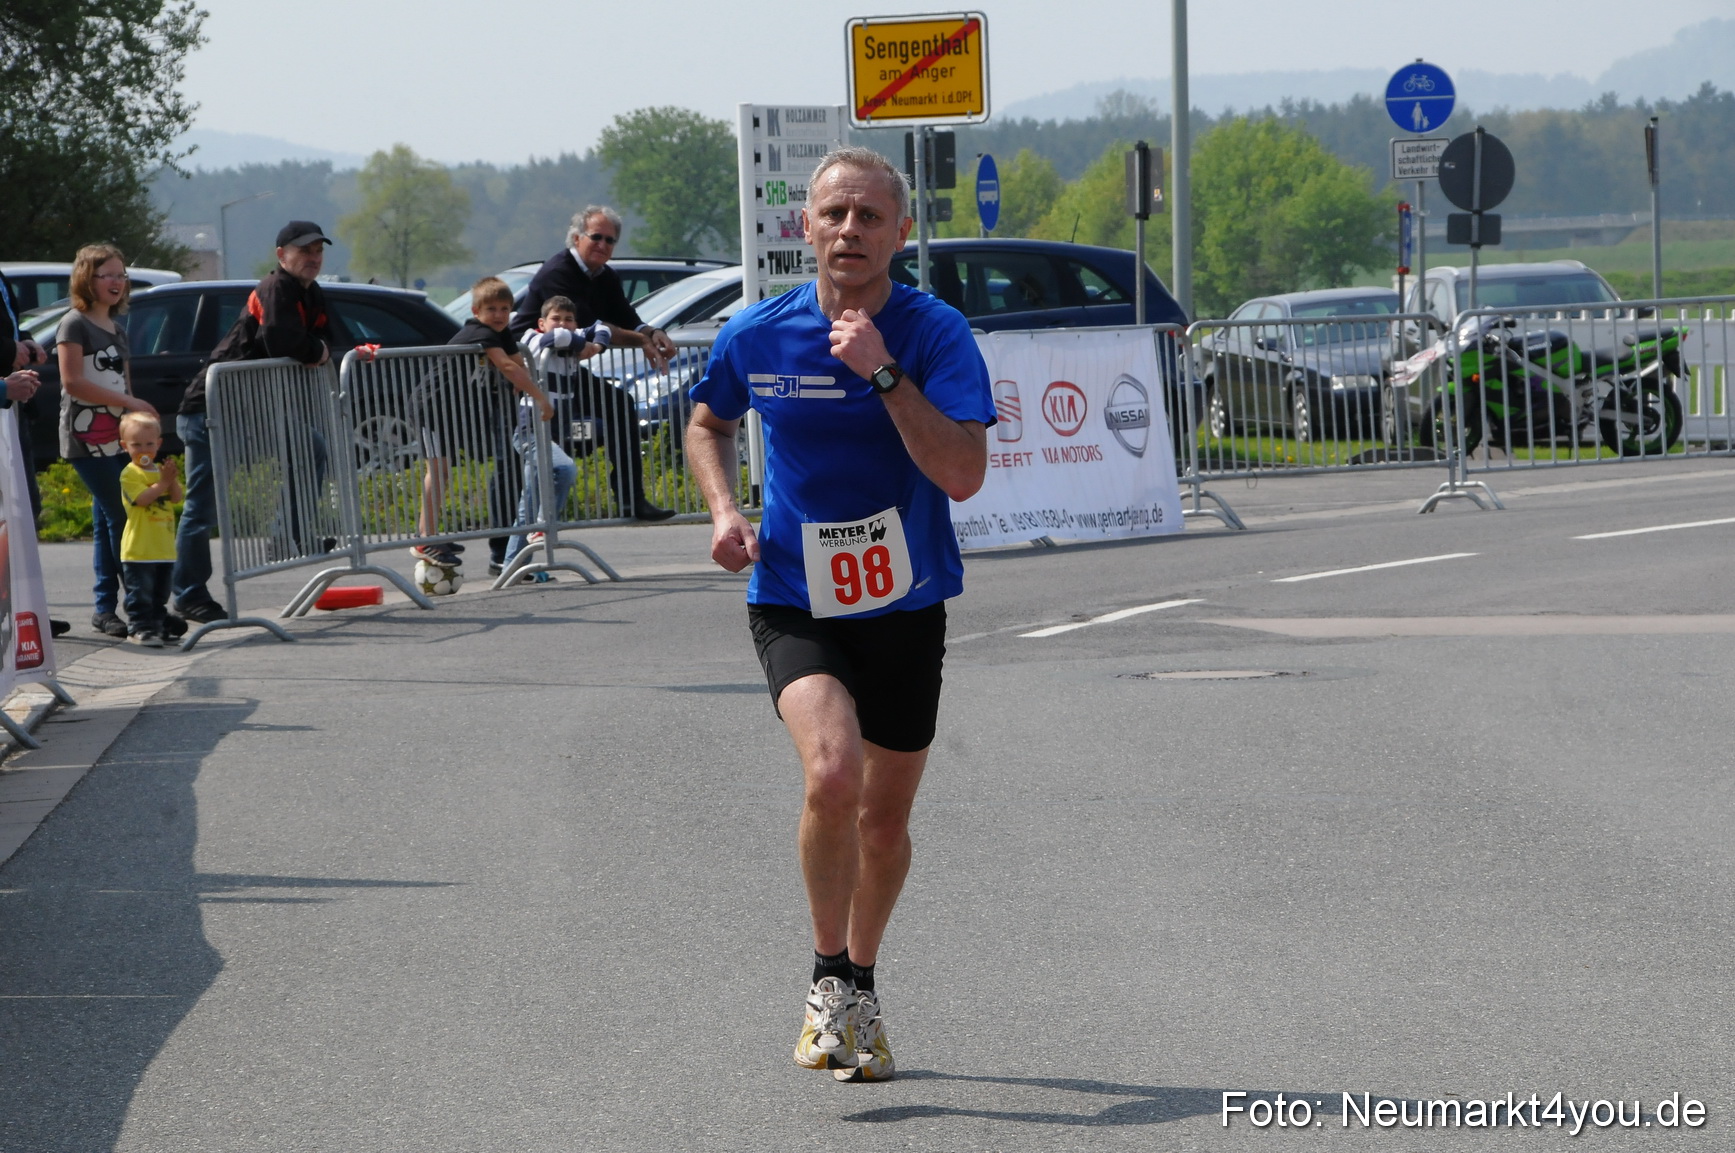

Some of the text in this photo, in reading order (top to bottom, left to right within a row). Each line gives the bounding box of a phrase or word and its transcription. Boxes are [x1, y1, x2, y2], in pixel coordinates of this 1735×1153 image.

[864, 32, 969, 64] Sengenthal
[880, 65, 956, 82] am Anger
[863, 95, 887, 107] Kreis
[891, 93, 938, 106] Neumarkt
[785, 108, 827, 124] HOLZAMMER
[786, 143, 828, 158] HOLZAMMER
[1401, 143, 1441, 154] Landwirt-
[1398, 155, 1441, 164] schaftliche
[1398, 165, 1428, 175] Verkehr
[766, 180, 787, 207] SHB
[767, 250, 803, 275] THULE
[1048, 394, 1079, 424] KIA
[989, 451, 1033, 468] SEAT
[1060, 444, 1103, 463] MOTORS
[818, 524, 867, 539] MEYER
[819, 535, 868, 549] WERBUNG
[830, 544, 895, 606] 98
[21, 640, 38, 652] KIA
